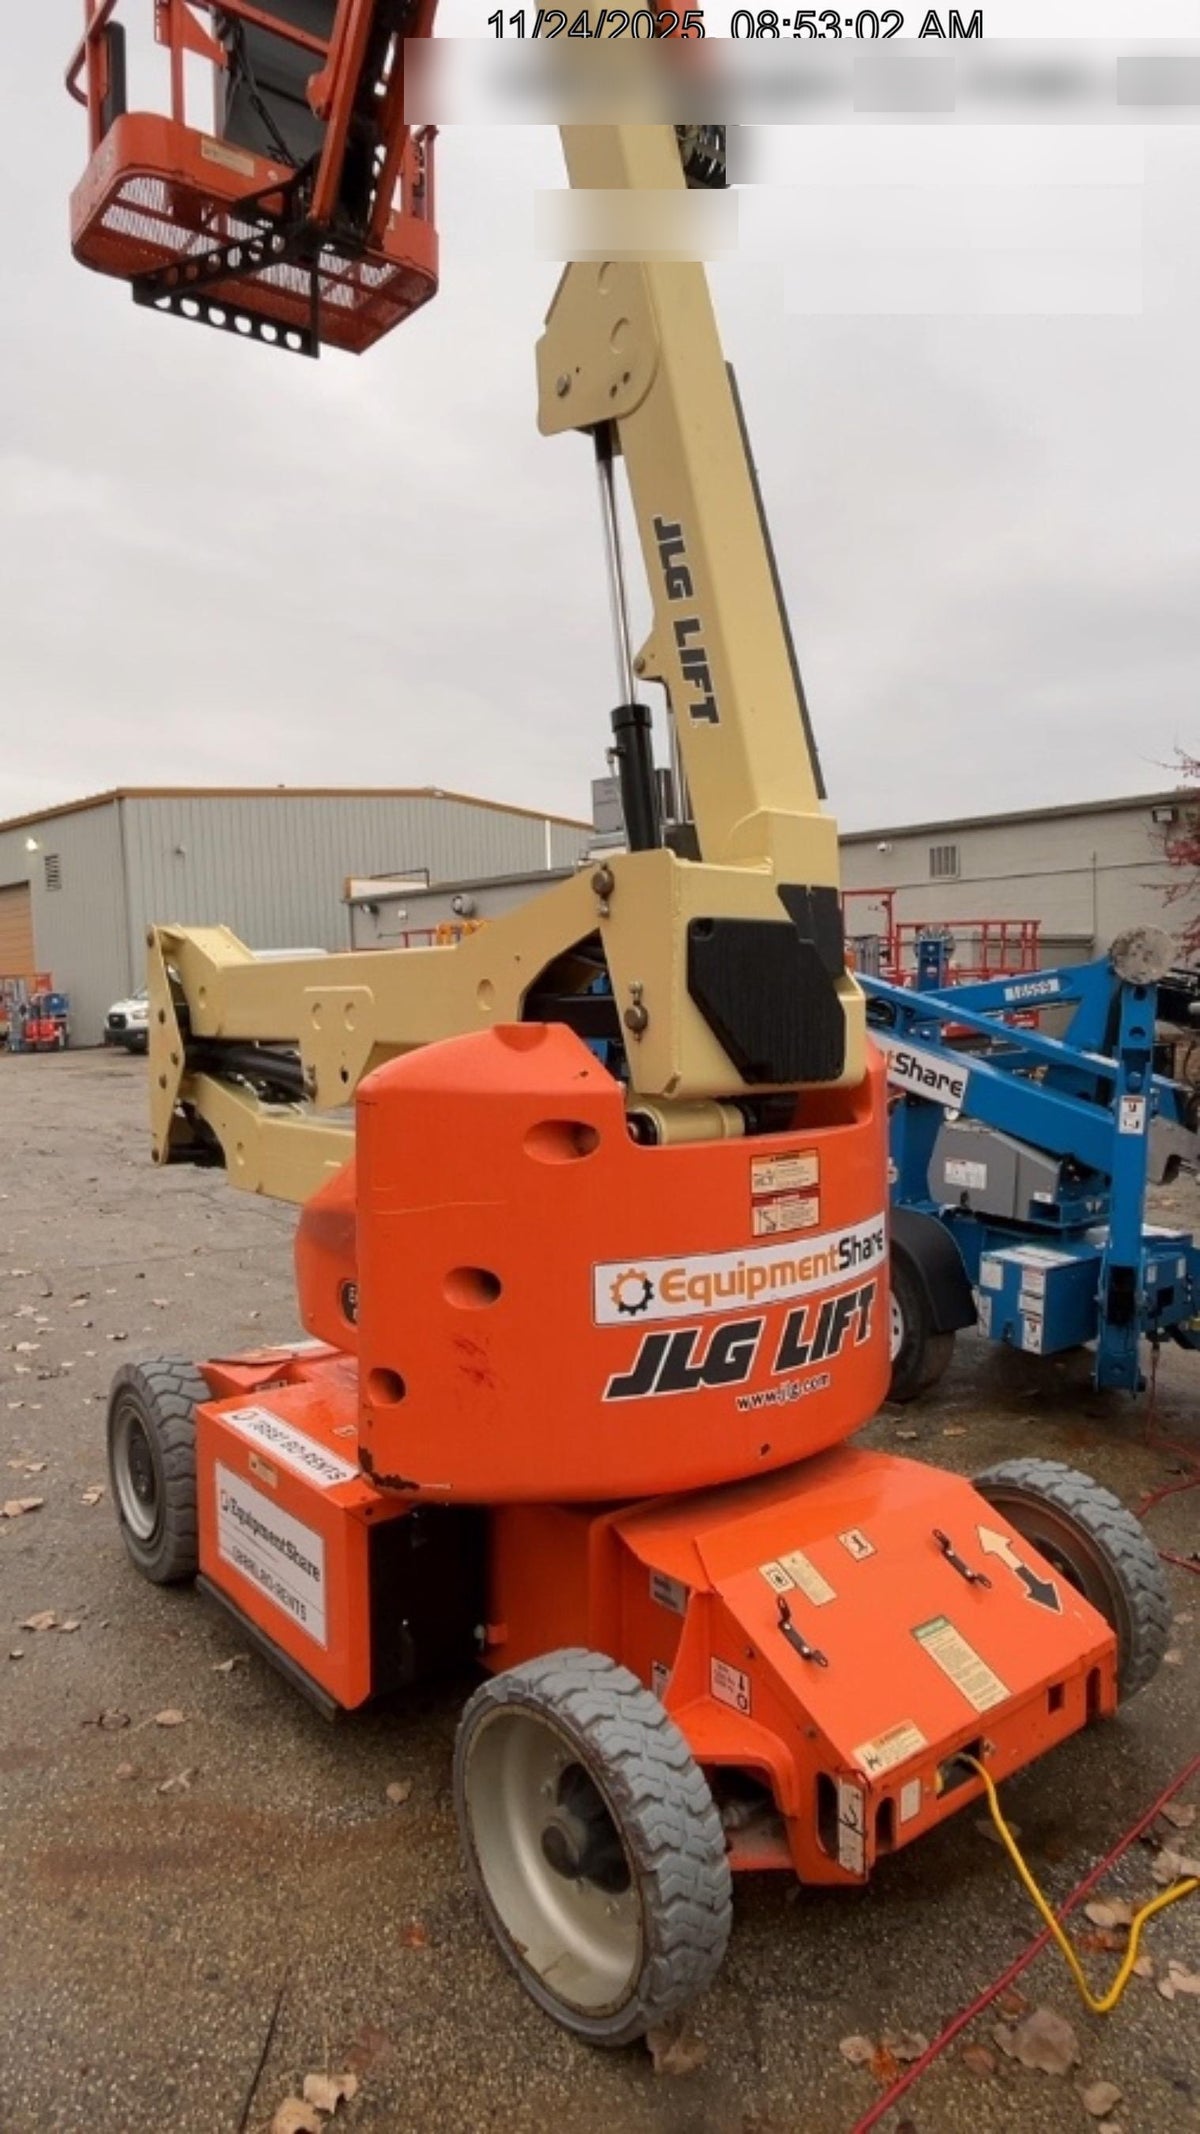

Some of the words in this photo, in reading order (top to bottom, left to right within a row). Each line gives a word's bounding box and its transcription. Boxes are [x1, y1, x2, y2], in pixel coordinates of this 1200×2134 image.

[652, 515, 694, 601] JLG
[672, 617, 720, 725] LIFT
[659, 1227, 884, 1307] EquipmentShare
[602, 1316, 766, 1402] JLG
[771, 1278, 878, 1376] LIFT
